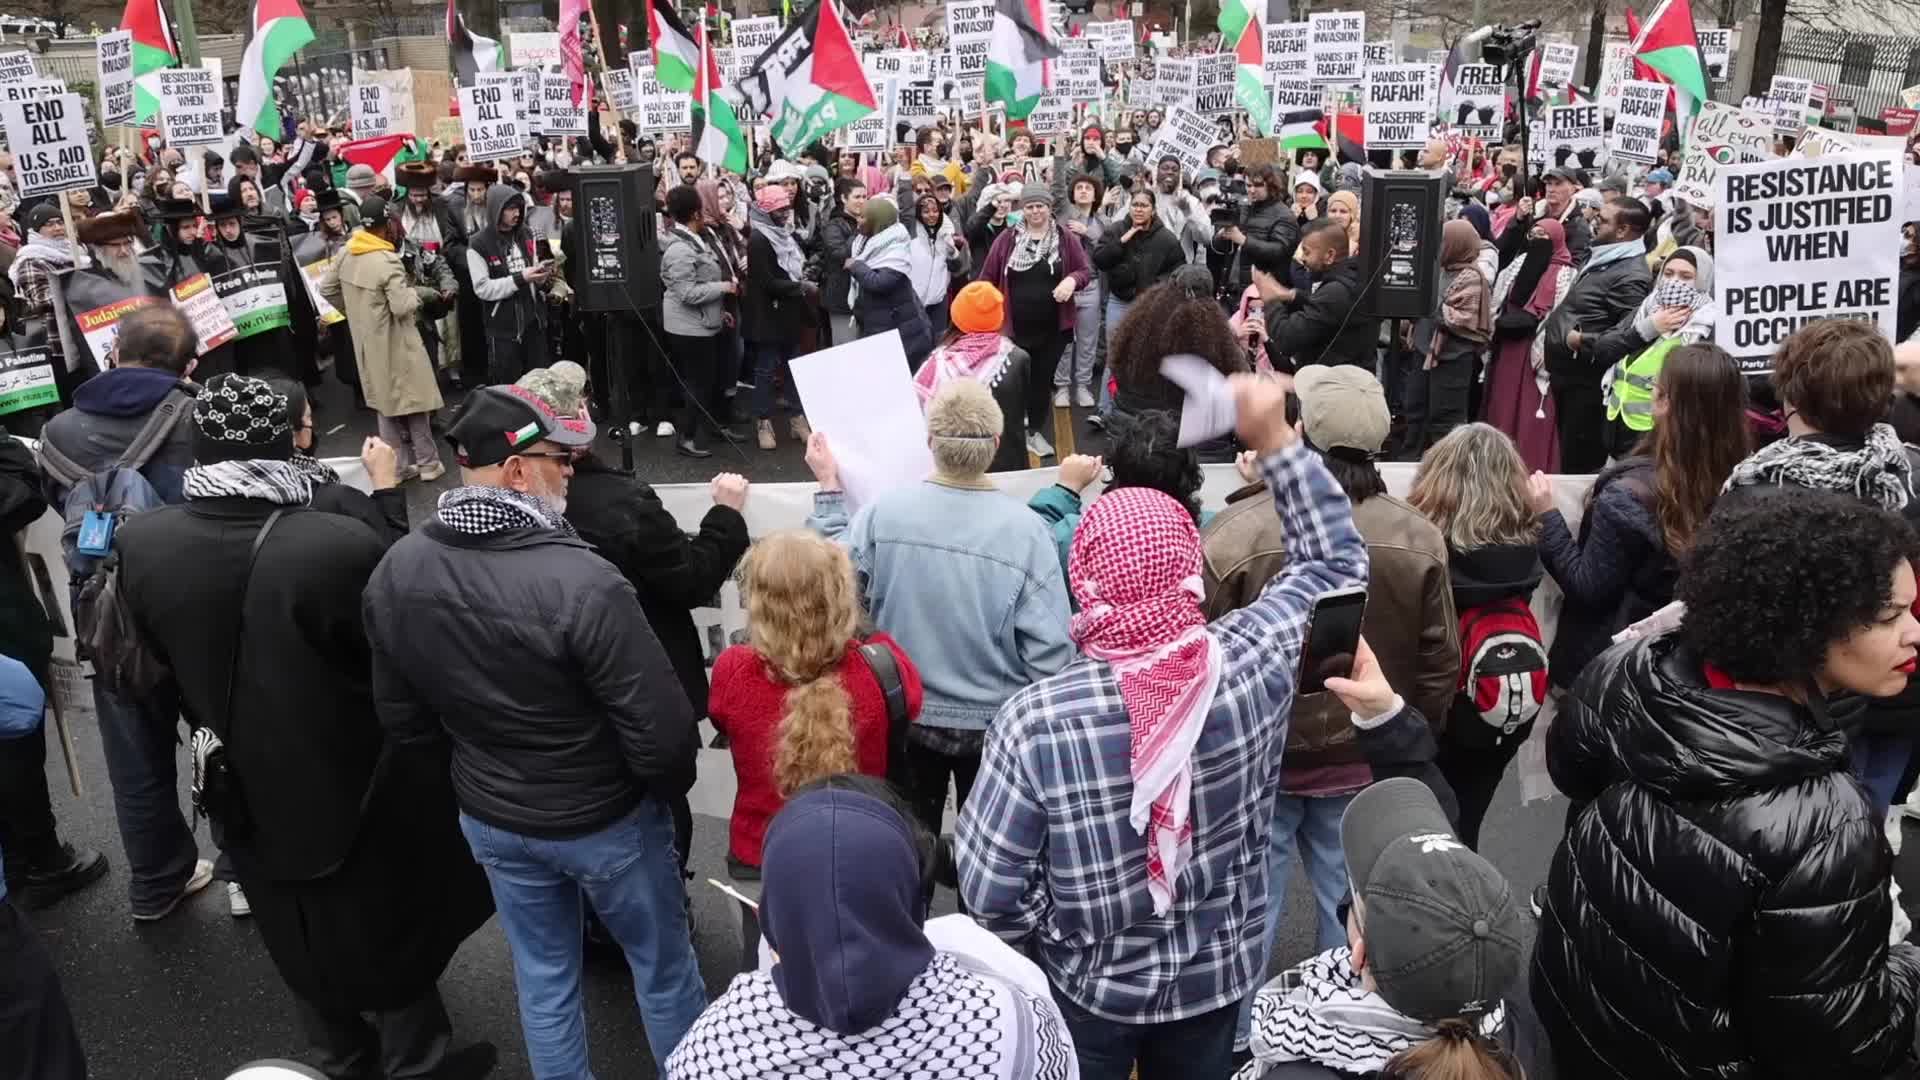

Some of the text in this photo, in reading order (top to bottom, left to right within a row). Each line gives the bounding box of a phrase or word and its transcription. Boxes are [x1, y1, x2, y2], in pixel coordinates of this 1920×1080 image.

[953, 5, 995, 21] STOP TH
[736, 22, 776, 33] HANDS OFF
[1315, 18, 1360, 31] STOP THE
[737, 33, 777, 48] RAFAH!
[1267, 28, 1308, 39] HANDS OFF
[1314, 31, 1360, 44] INVASION!
[101, 42, 119, 58] STOP
[955, 42, 987, 55] HANDS
[1267, 40, 1307, 54] RAFAH!
[1363, 45, 1387, 60] REE
[1314, 51, 1360, 62] HANDS OFF
[876, 57, 900, 71] END
[1265, 60, 1307, 72] CEASEFIRE
[1316, 62, 1355, 76] RAFAH!
[160, 71, 212, 83] RESISTANCE
[544, 78, 571, 87] HANDS
[608, 70, 629, 84] REE
[1197, 71, 1235, 86] END THE
[1371, 70, 1426, 82] HANDS OFF
[162, 83, 214, 95] IS JUSTIFIED
[1279, 80, 1308, 91] HANDS
[1456, 85, 1502, 96] PALESTINE
[1623, 86, 1664, 99] HANDS OFF
[1774, 81, 1808, 91] HANDS OFF
[360, 86, 380, 101] END
[472, 86, 501, 105] END
[1279, 92, 1322, 107] RAFAH!
[1371, 84, 1425, 102] RAFAH!
[177, 95, 204, 106] WHEN
[363, 101, 380, 114] ALL
[644, 101, 686, 112] HANDS OFF
[1196, 92, 1233, 112] NOW!
[22, 99, 64, 125] END
[478, 102, 503, 121] ALL
[896, 106, 937, 116] ALESTINE
[1621, 98, 1661, 119] RAFAH!
[167, 113, 199, 125] PEOPLE
[202, 112, 218, 123] ARE
[551, 117, 578, 129] NOW!
[647, 112, 683, 124] RAFAH!
[1031, 112, 1056, 120] PEOPLE
[1175, 107, 1217, 137] RESISTANCE
[1368, 111, 1426, 124] CEASEFIRE
[1552, 106, 1599, 129] FREE
[171, 124, 217, 138] OCCUPIED!
[355, 117, 388, 131] U.S. AID
[1615, 122, 1658, 140] CEASEFIRE
[1698, 112, 1728, 139] all
[32, 121, 67, 146] ALL
[469, 126, 494, 142] U.S.
[496, 123, 515, 138] AID
[855, 131, 877, 144] NOW!
[1178, 122, 1213, 146] JUSTIFIED
[1378, 125, 1415, 140] NOW!
[1550, 126, 1601, 140] PALESTINE
[470, 138, 519, 153] TO ISRAEL!
[1175, 132, 1198, 149] WHEN
[1621, 138, 1648, 154] NOW!
[19, 145, 86, 173] U.S. AID
[1159, 139, 1201, 169] PEOPLE ARE
[22, 164, 90, 187] TO ISRAEL!
[1726, 160, 1893, 203] RESISTANCE
[1727, 194, 1892, 234] IS JUSTIFIED
[1766, 230, 1849, 262] WHEN
[215, 277, 242, 293] Free
[1726, 277, 1891, 316] PEOPLE ARE
[84, 304, 136, 328] Judaism
[1741, 358, 1765, 370] Party
